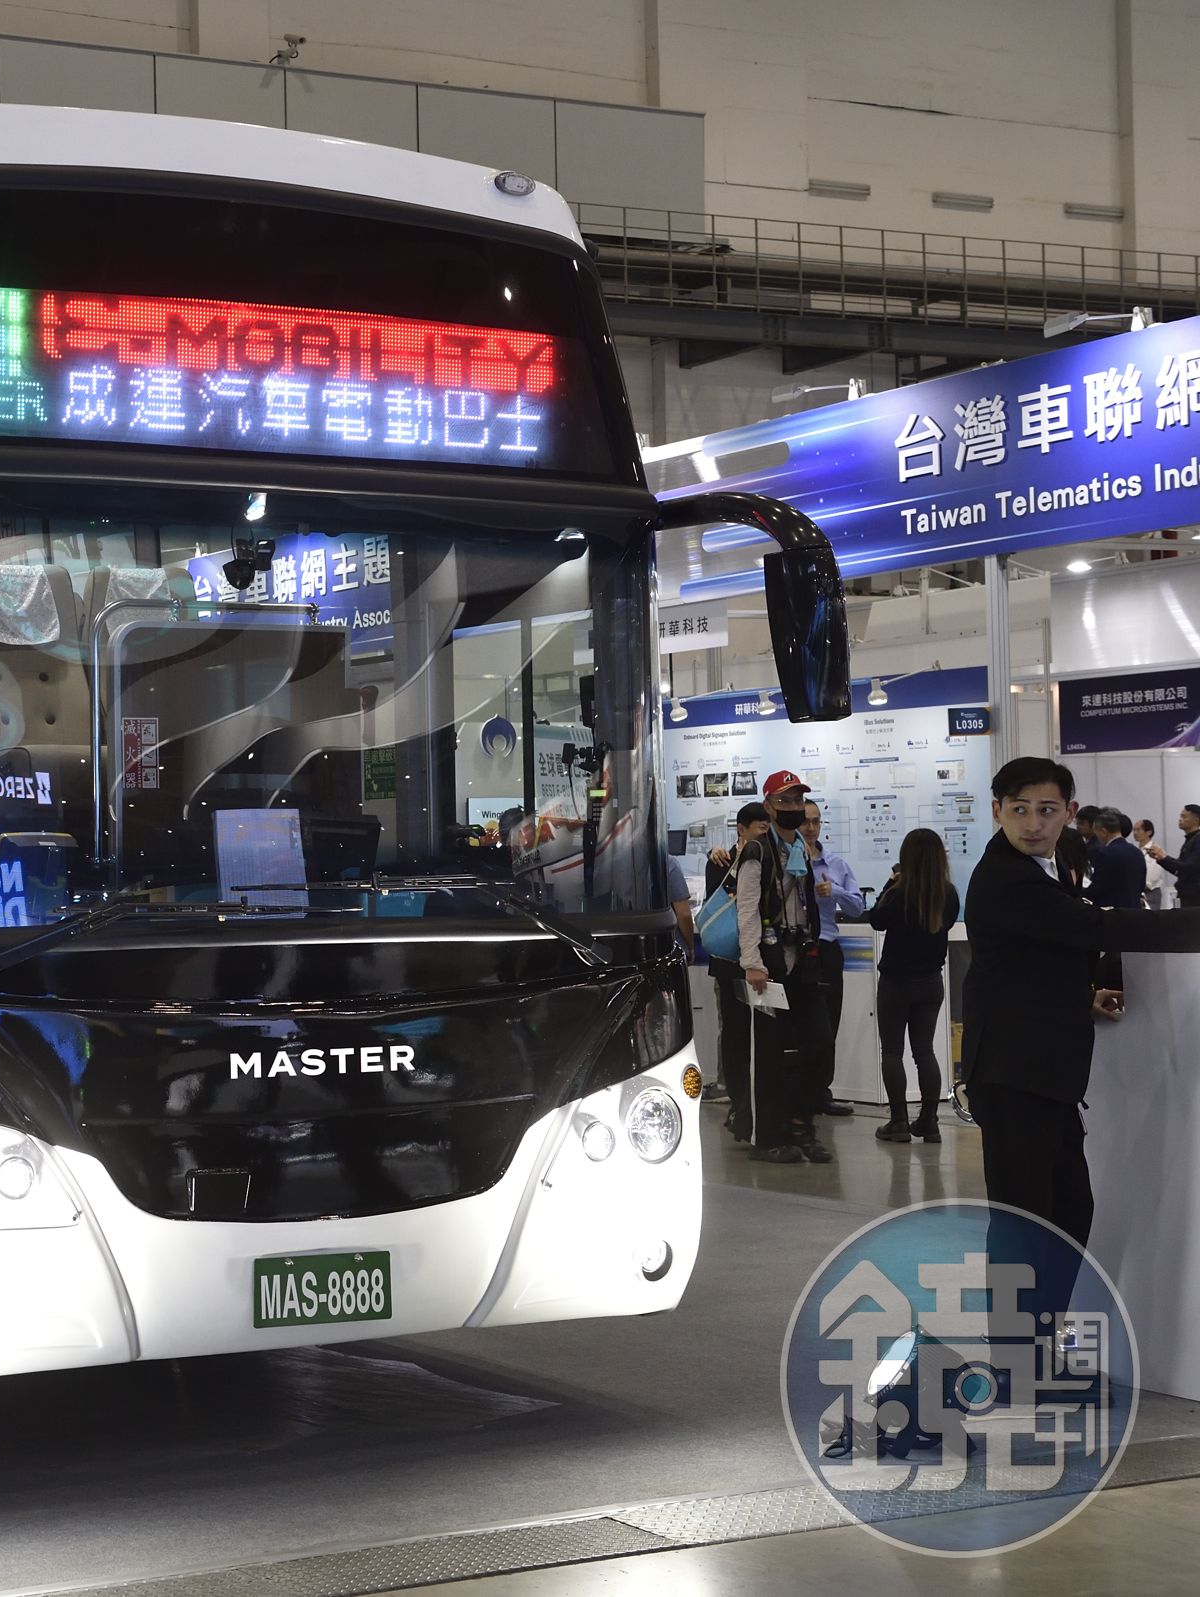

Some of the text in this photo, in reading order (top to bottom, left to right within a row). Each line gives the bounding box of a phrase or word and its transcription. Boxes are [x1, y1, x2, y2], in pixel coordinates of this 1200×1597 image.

[62, 364, 541, 453] 成運汽車電動巴士
[901, 456, 1200, 535] Taiwan Telematics Ind
[955, 719, 984, 730] L0305
[1122, 703, 1174, 716] MICROSYSTEMS
[229, 1045, 415, 1079] MASTER
[260, 1268, 385, 1320] MAS-8888
